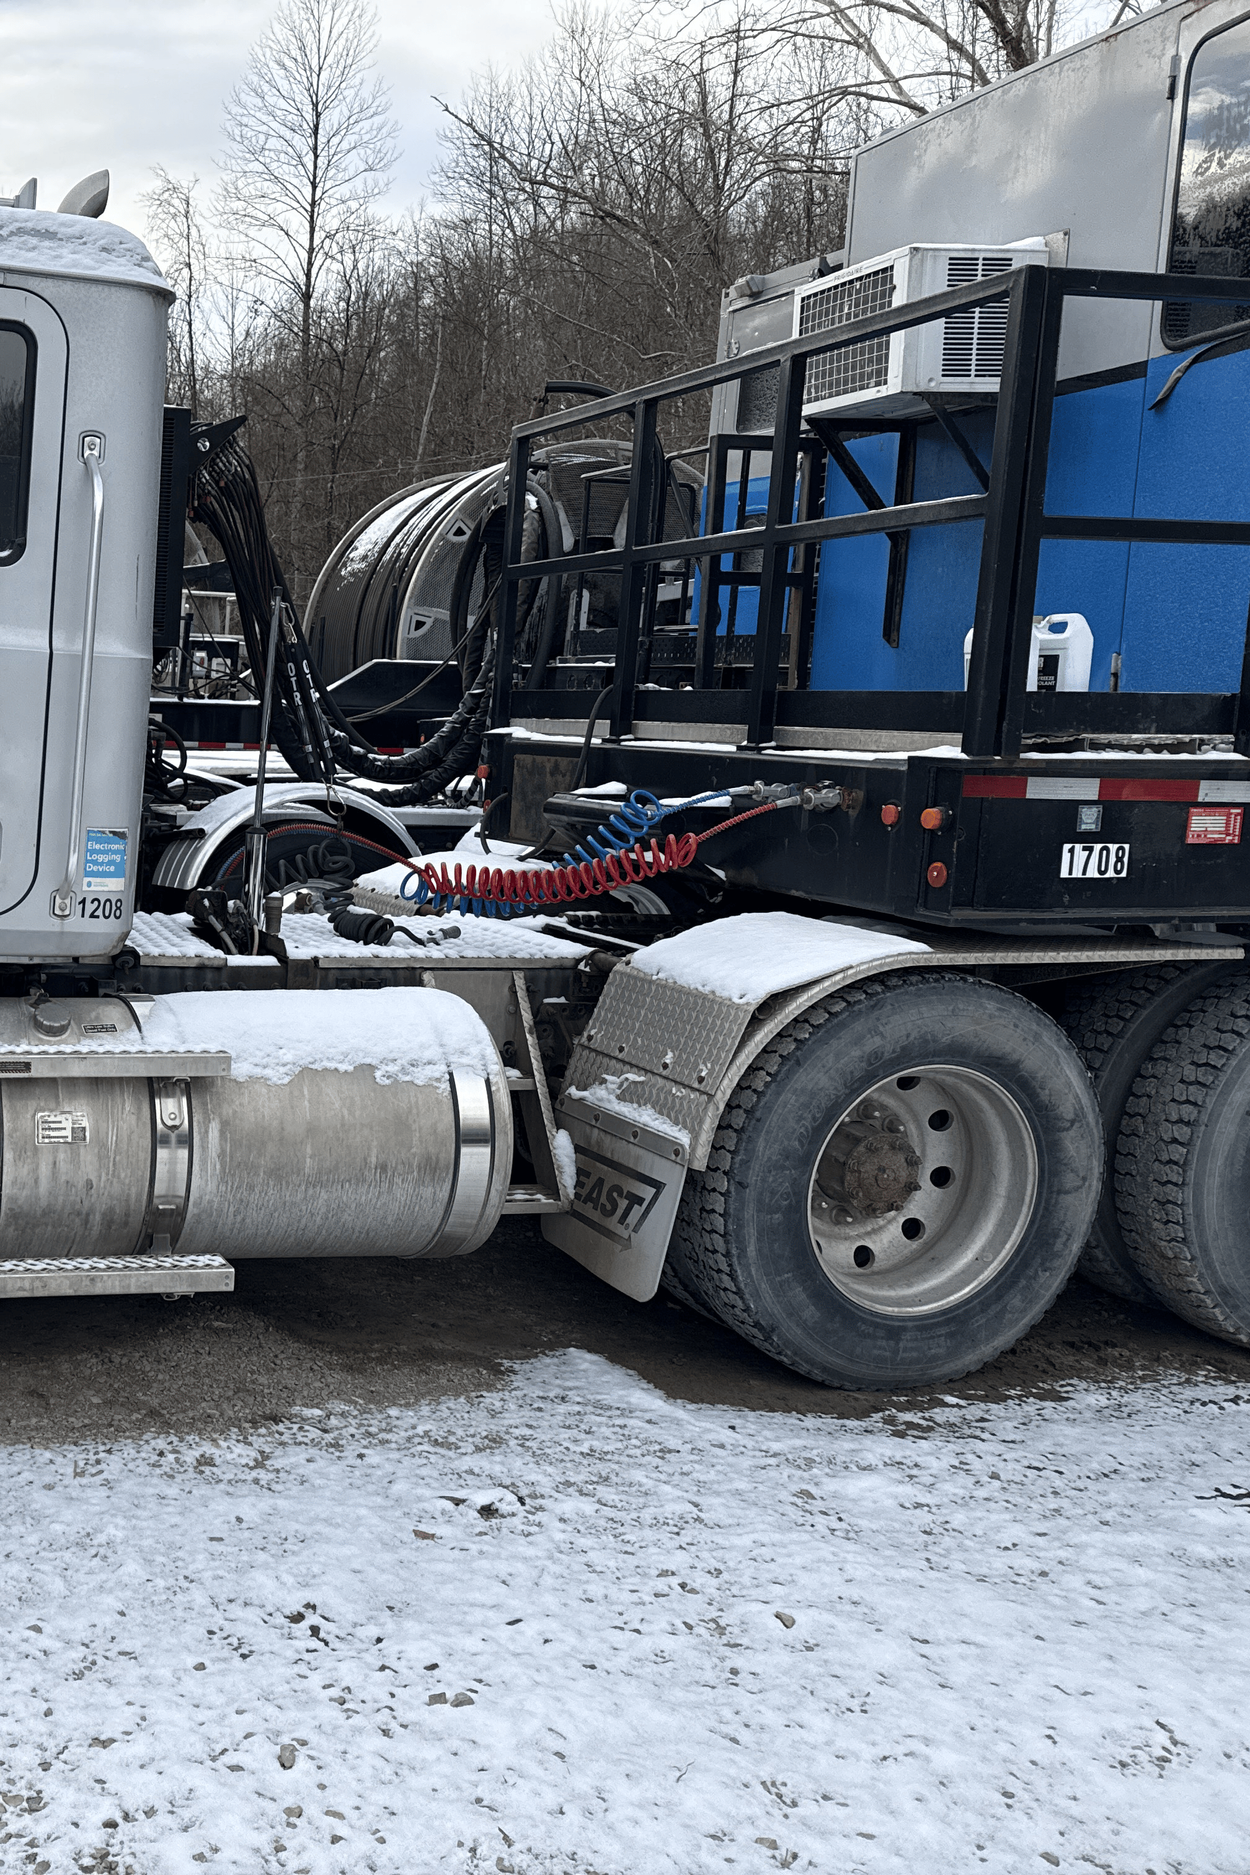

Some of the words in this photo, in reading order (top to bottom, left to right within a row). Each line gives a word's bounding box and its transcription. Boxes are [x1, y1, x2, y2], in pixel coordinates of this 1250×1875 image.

[287, 662, 302, 706] OTR
[87, 842, 125, 850] Electronic
[87, 852, 121, 862] Logging
[86, 864, 115, 872] Device
[1067, 845, 1126, 876] 1708
[78, 897, 123, 920] 1208
[574, 1166, 646, 1226] EAST
